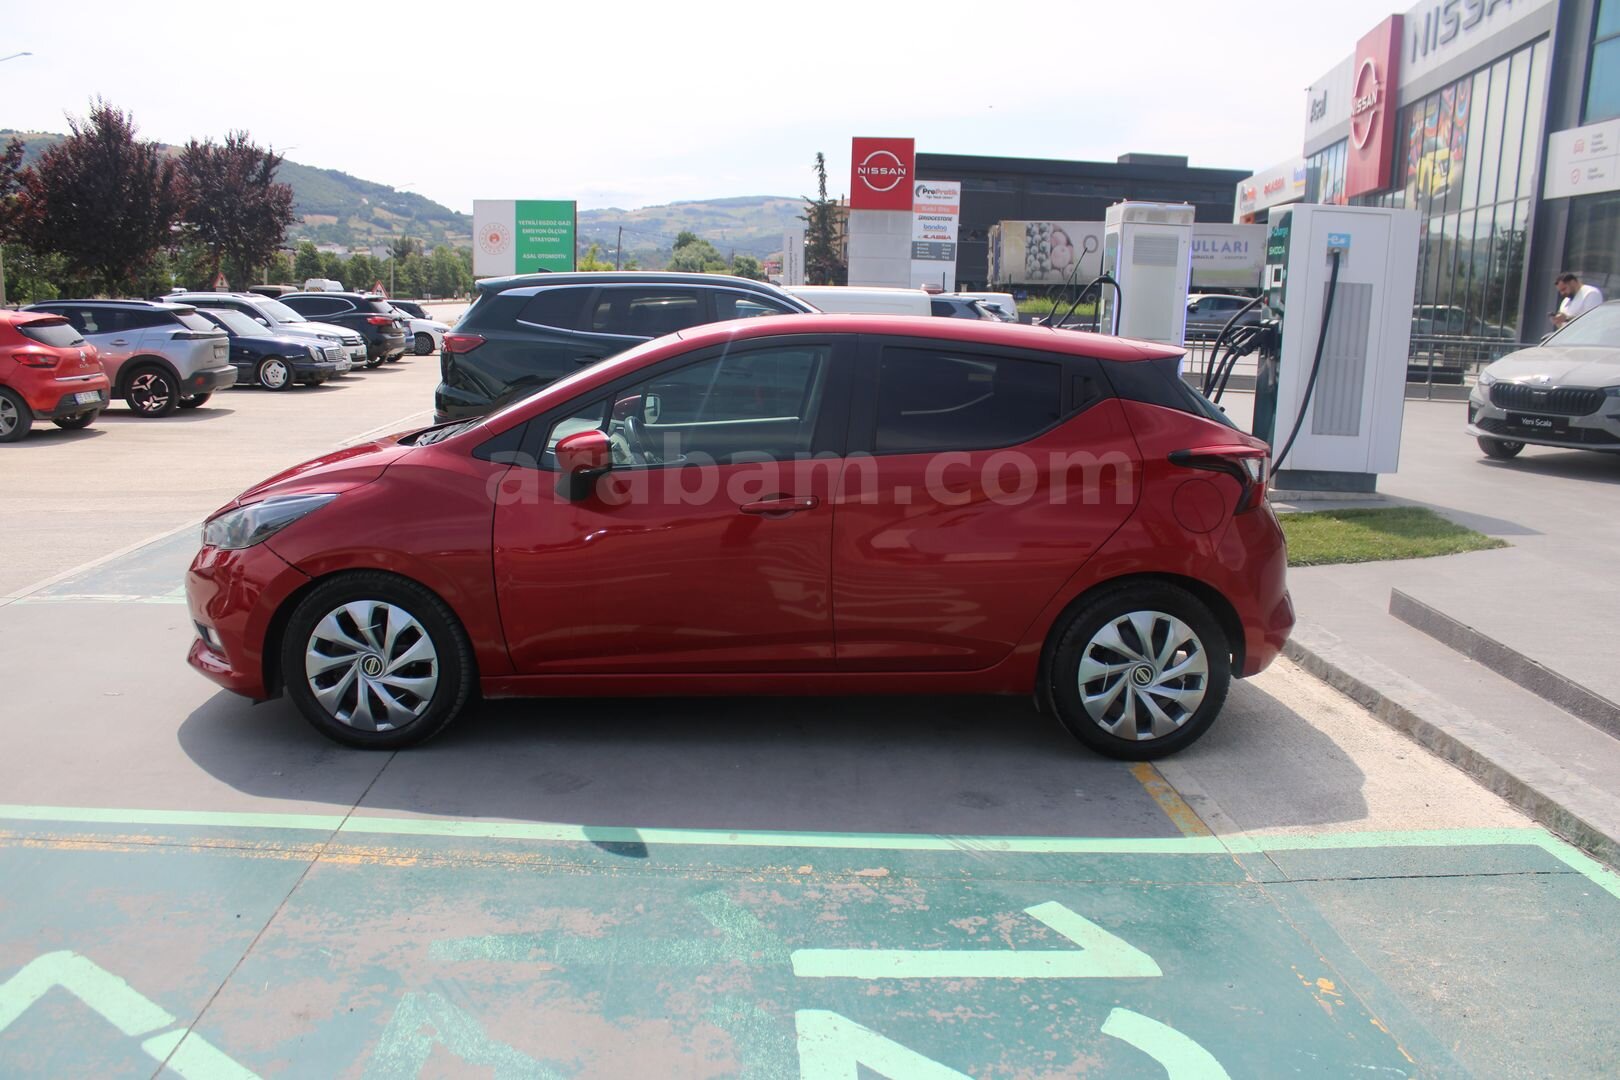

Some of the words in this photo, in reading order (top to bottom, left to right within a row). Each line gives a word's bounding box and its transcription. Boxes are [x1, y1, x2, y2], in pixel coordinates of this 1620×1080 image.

[1409, 0, 1512, 64] NISS
[1351, 89, 1378, 116] NISSAN
[858, 167, 906, 175] NISSAN
[1521, 417, 1535, 425] Yeni
[1535, 418, 1552, 427] Scala
